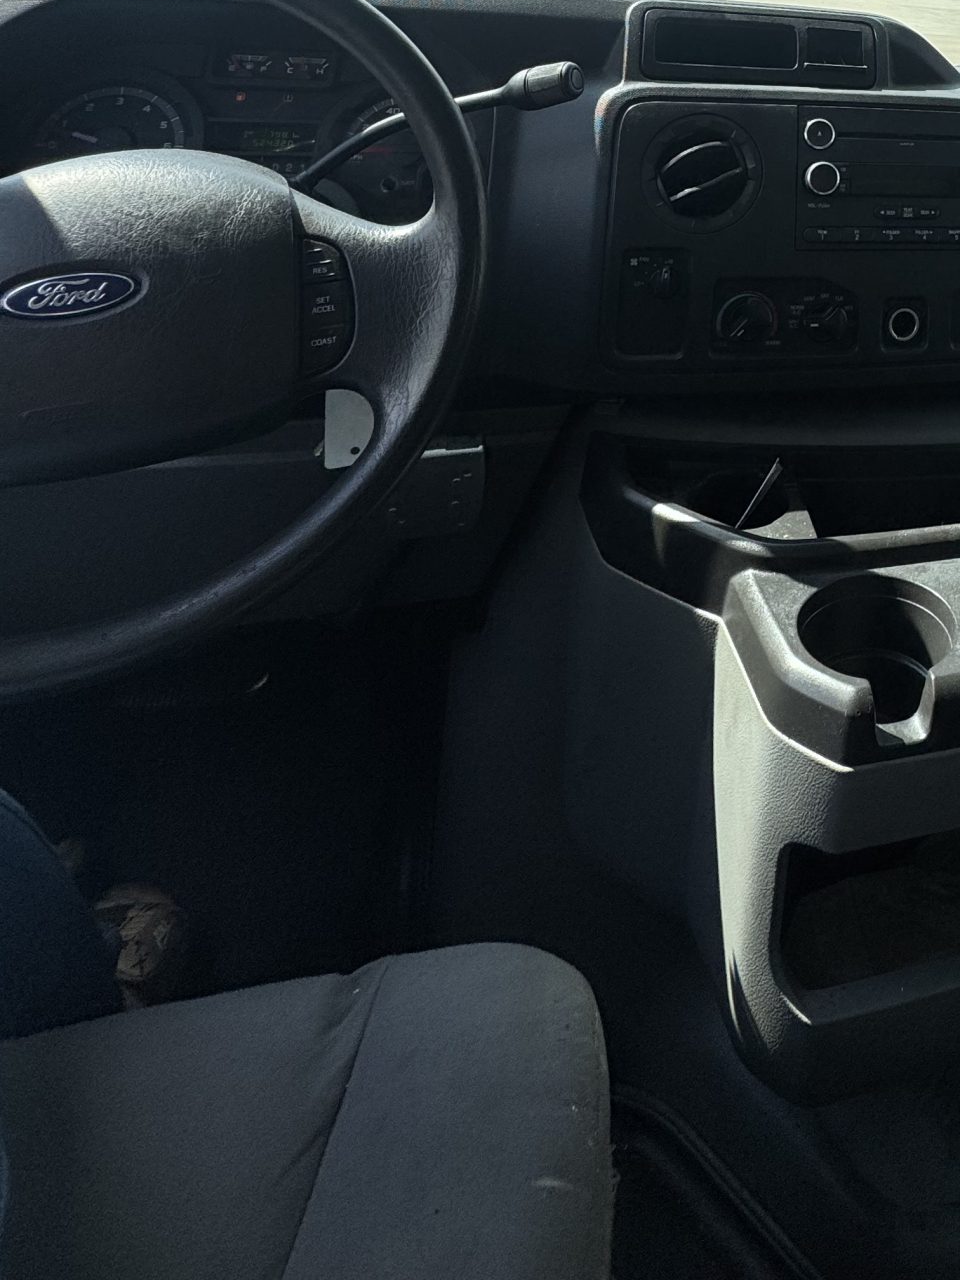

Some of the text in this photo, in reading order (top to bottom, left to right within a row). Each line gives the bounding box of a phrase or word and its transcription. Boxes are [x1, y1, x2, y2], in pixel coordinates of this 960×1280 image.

[313, 266, 328, 275] RES
[28, 279, 108, 309] Ford
[316, 296, 330, 304] SET
[312, 306, 336, 315] ACCEL
[311, 336, 337, 347] COAST
